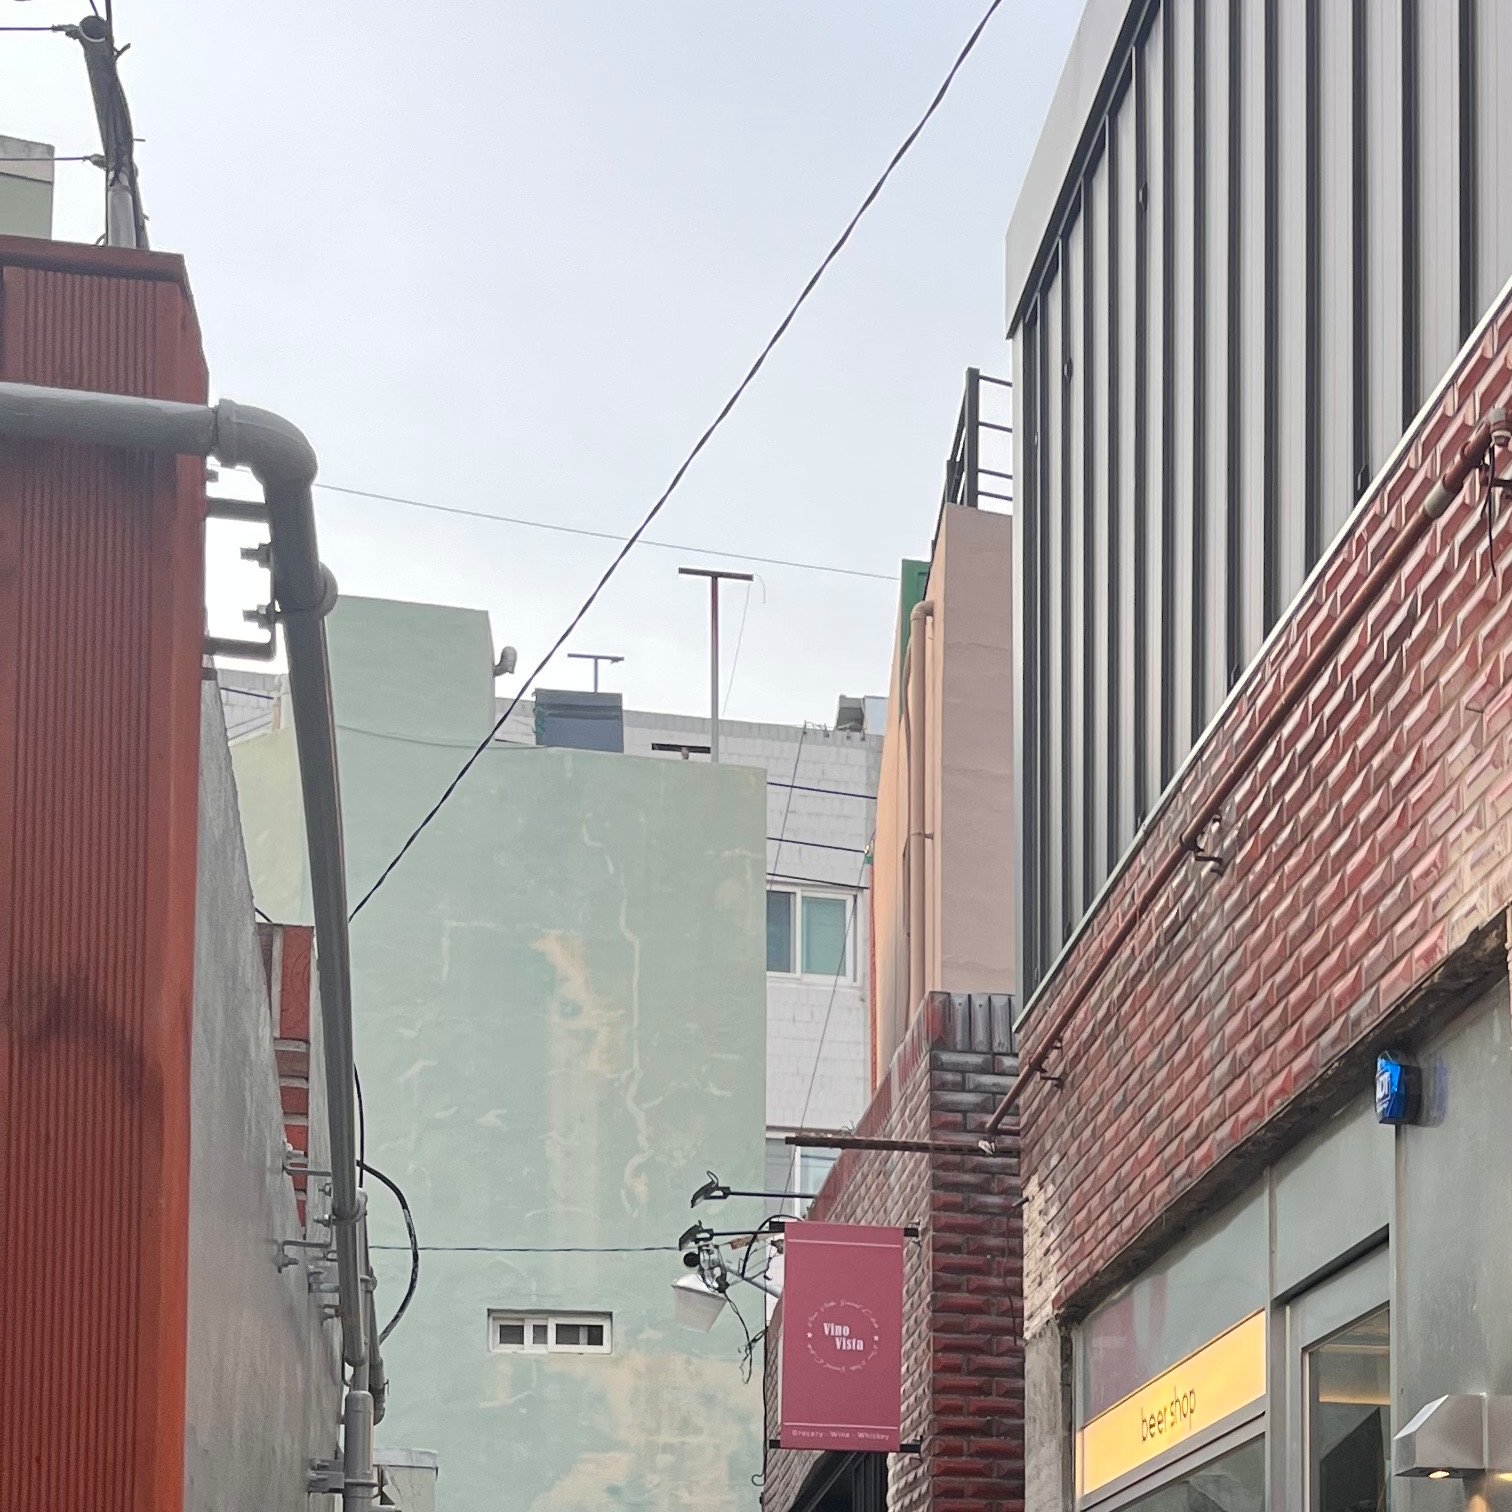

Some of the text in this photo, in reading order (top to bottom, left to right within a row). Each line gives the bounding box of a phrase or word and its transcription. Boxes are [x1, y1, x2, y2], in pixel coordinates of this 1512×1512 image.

[823, 1322, 850, 1337] Vino
[834, 1336, 864, 1351] Vista
[1141, 1385, 1196, 1444] beer shop
[792, 1429, 824, 1438] Grocery
[857, 1431, 890, 1441] Whiskey
